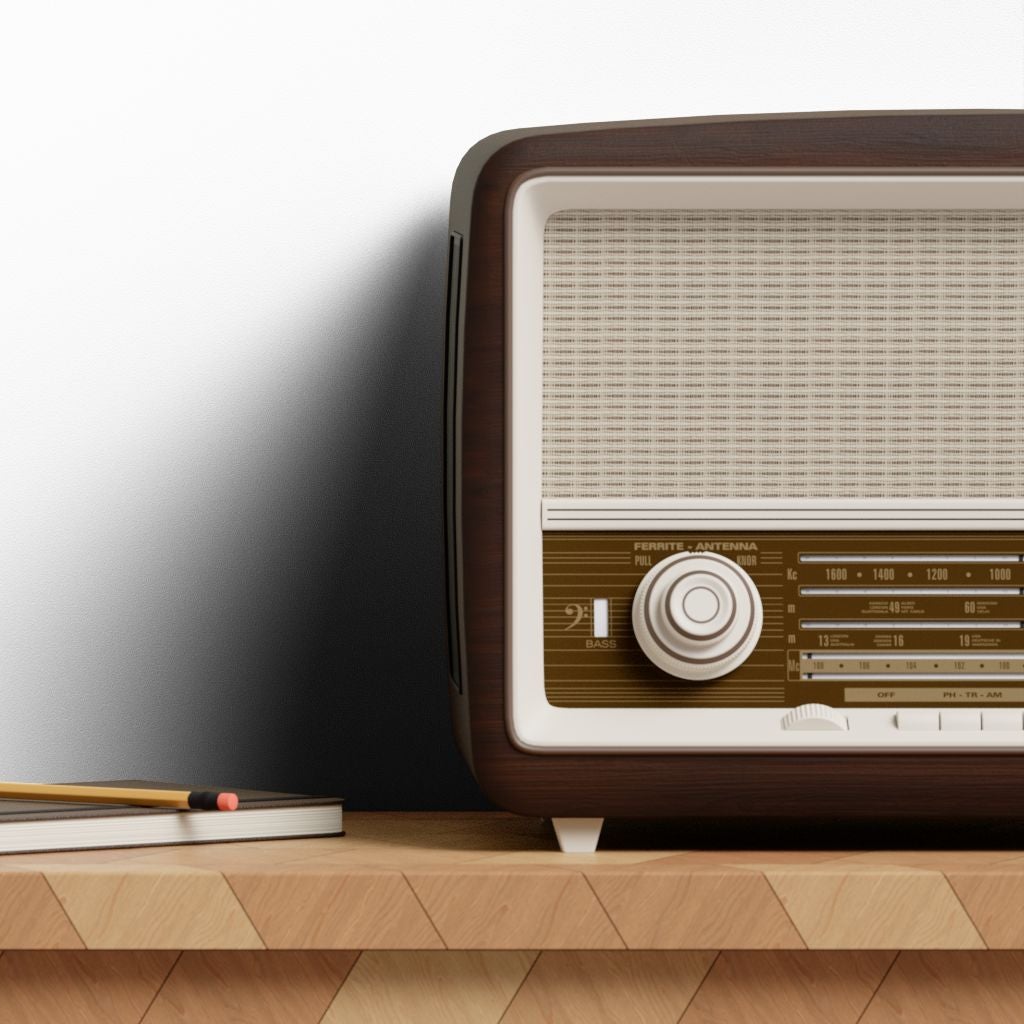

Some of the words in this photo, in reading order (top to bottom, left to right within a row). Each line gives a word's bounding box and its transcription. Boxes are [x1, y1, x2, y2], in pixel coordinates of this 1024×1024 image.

[633, 541, 685, 552] FERRITE
[695, 541, 758, 552] ANTENNA
[634, 554, 653, 566] PULL
[825, 568, 848, 581] 1600
[873, 568, 895, 581] 1400
[926, 568, 948, 581] 1200
[989, 568, 1012, 581] 1000
[888, 601, 901, 614] 49
[964, 601, 976, 614] 60
[585, 639, 617, 649] BASS
[818, 634, 830, 647] 13
[893, 634, 905, 647] 16
[959, 634, 971, 647] 19
[877, 691, 896, 699] OFF
[986, 691, 1003, 699] AM
